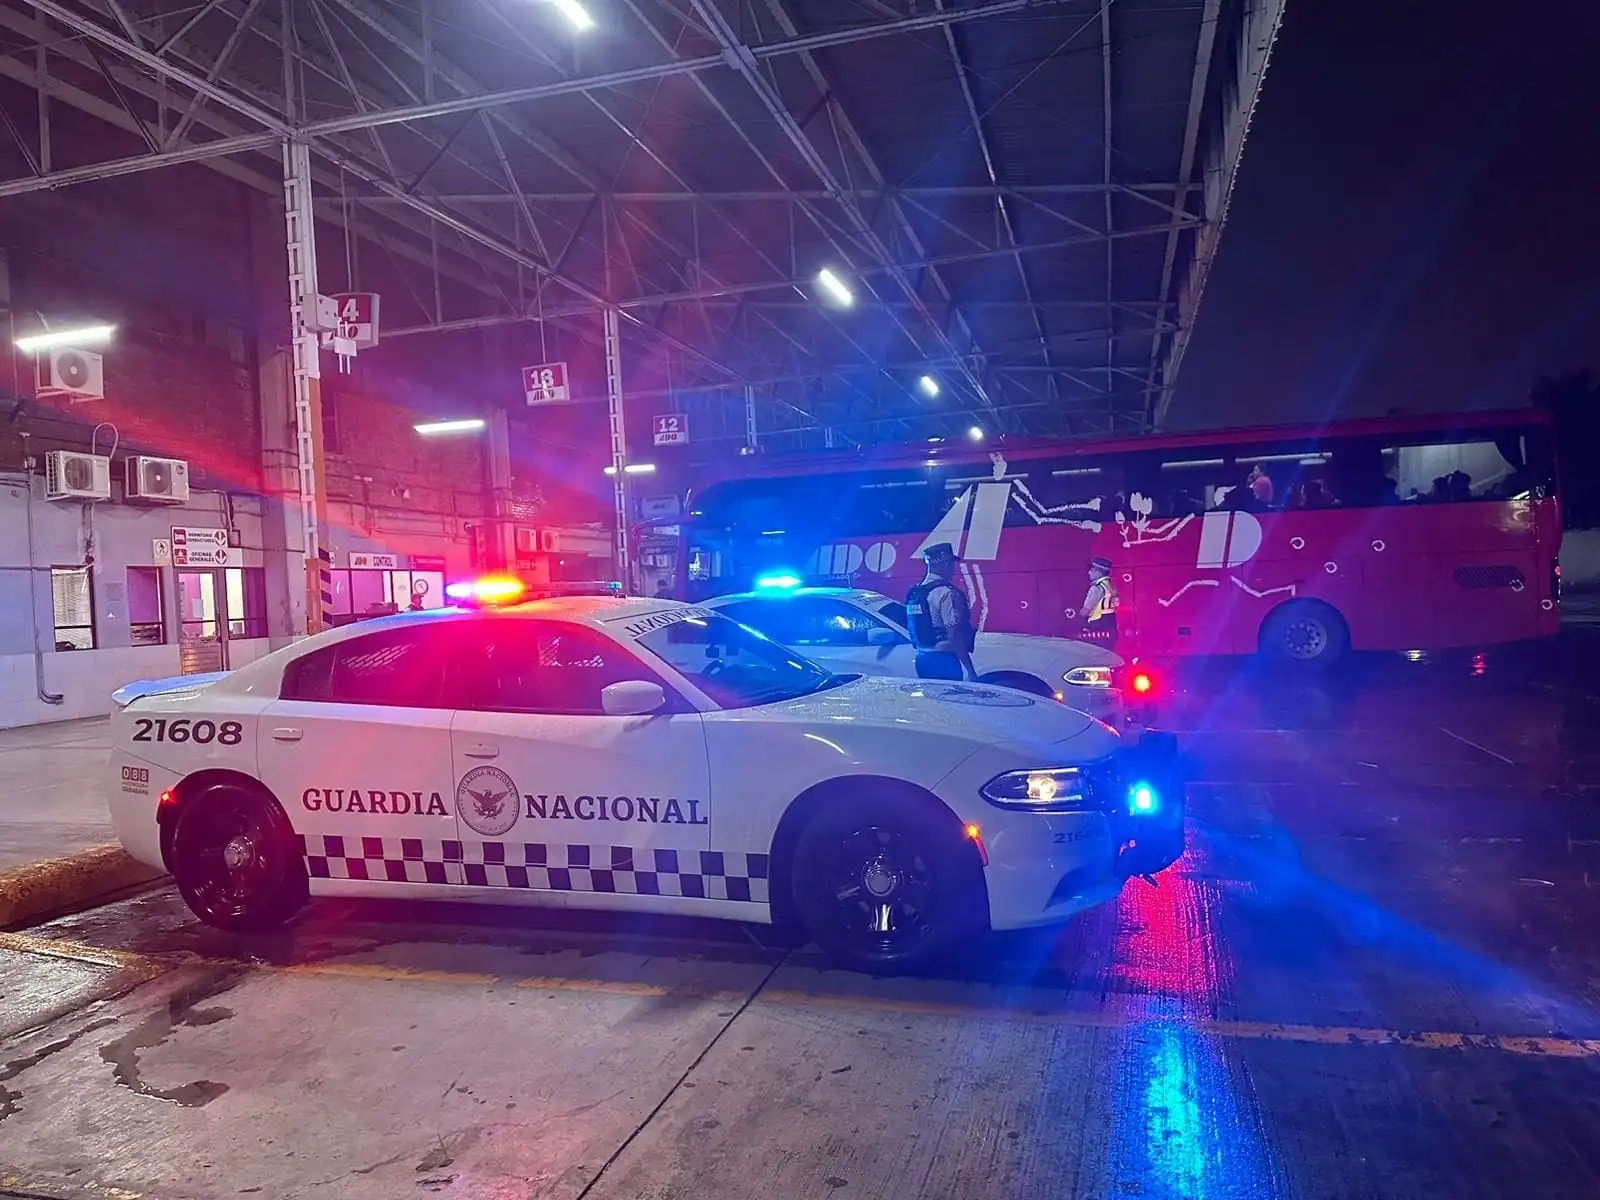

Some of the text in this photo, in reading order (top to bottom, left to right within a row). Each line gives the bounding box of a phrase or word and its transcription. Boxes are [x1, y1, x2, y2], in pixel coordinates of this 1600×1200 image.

[660, 418, 678, 432] 12
[373, 556, 393, 567] CONTROL
[804, 542, 897, 574] ADO
[132, 718, 243, 746] 21608
[123, 767, 148, 781] 088
[302, 787, 709, 825] GUARDIA NACIONAL
